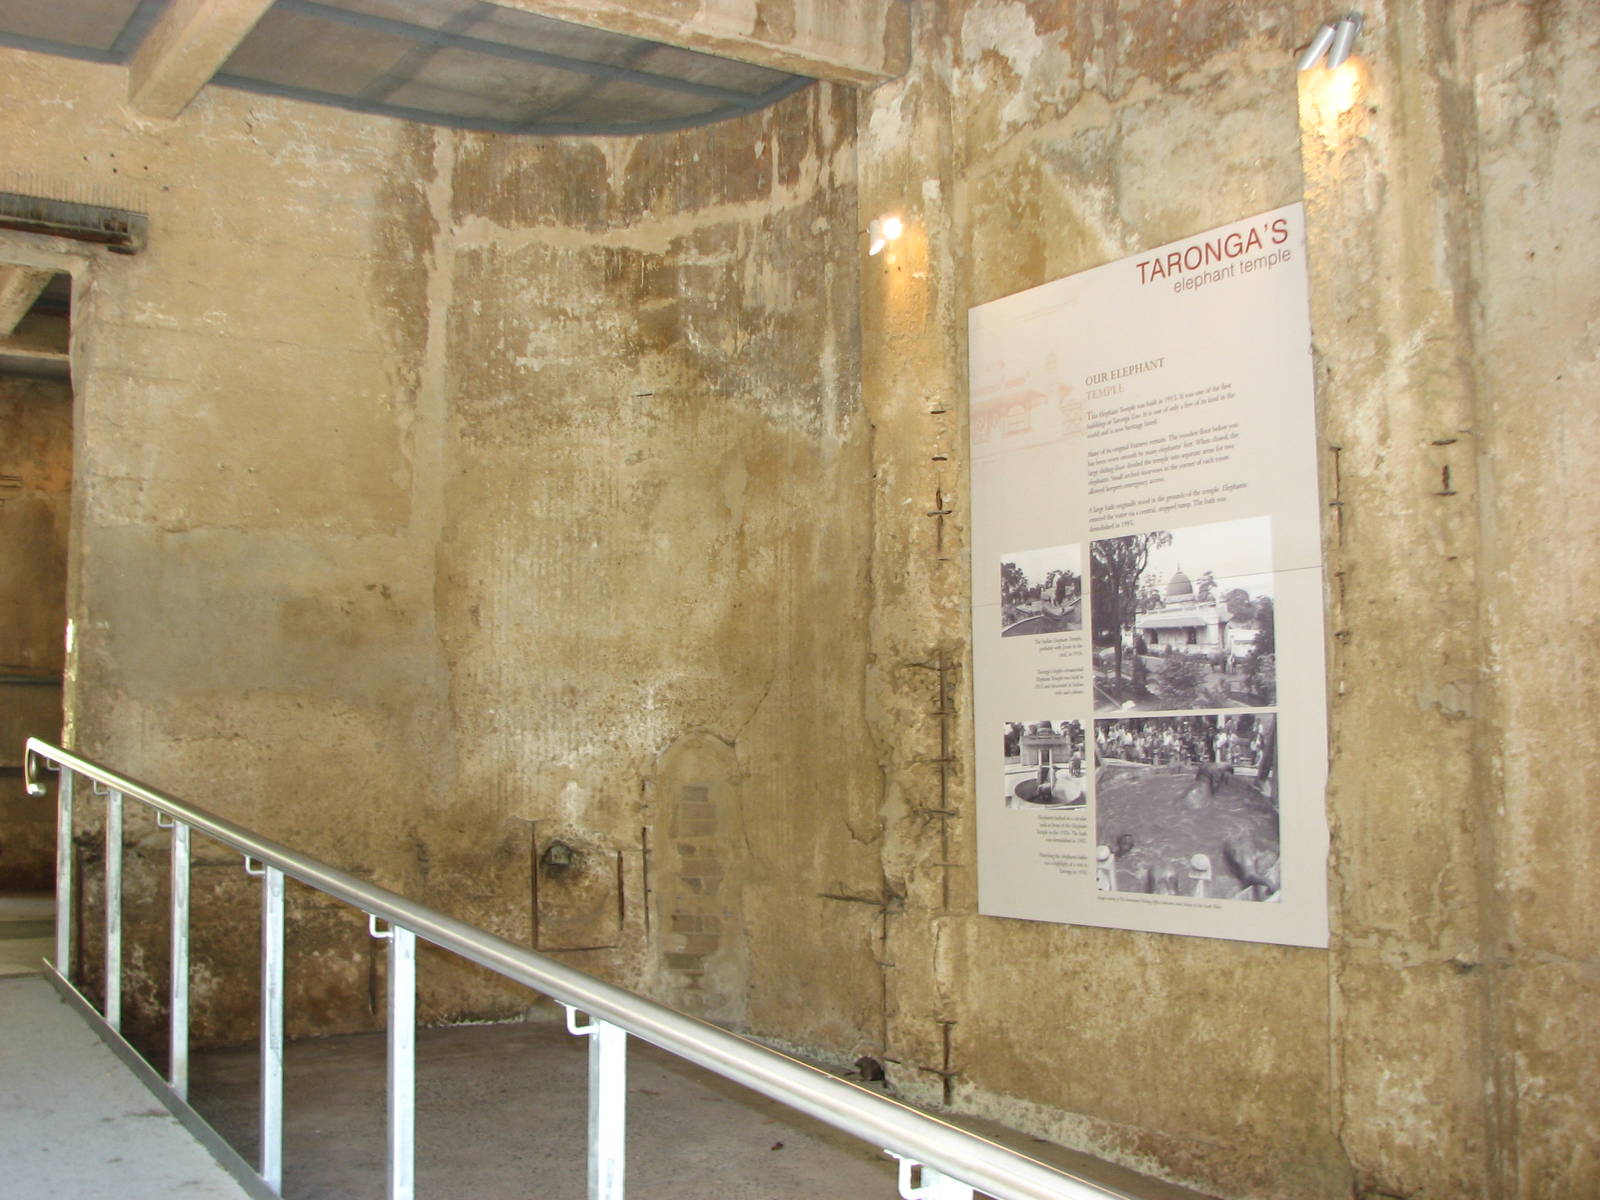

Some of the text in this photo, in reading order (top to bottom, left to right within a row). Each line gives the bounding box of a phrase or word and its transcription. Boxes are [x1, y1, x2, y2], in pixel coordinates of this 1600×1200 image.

[1136, 218, 1288, 285] TARONGA'S
[1174, 248, 1291, 293] elephant temple
[1085, 357, 1166, 386] OUR ELEPHANT
[1087, 383, 1125, 401] TEMPLE
